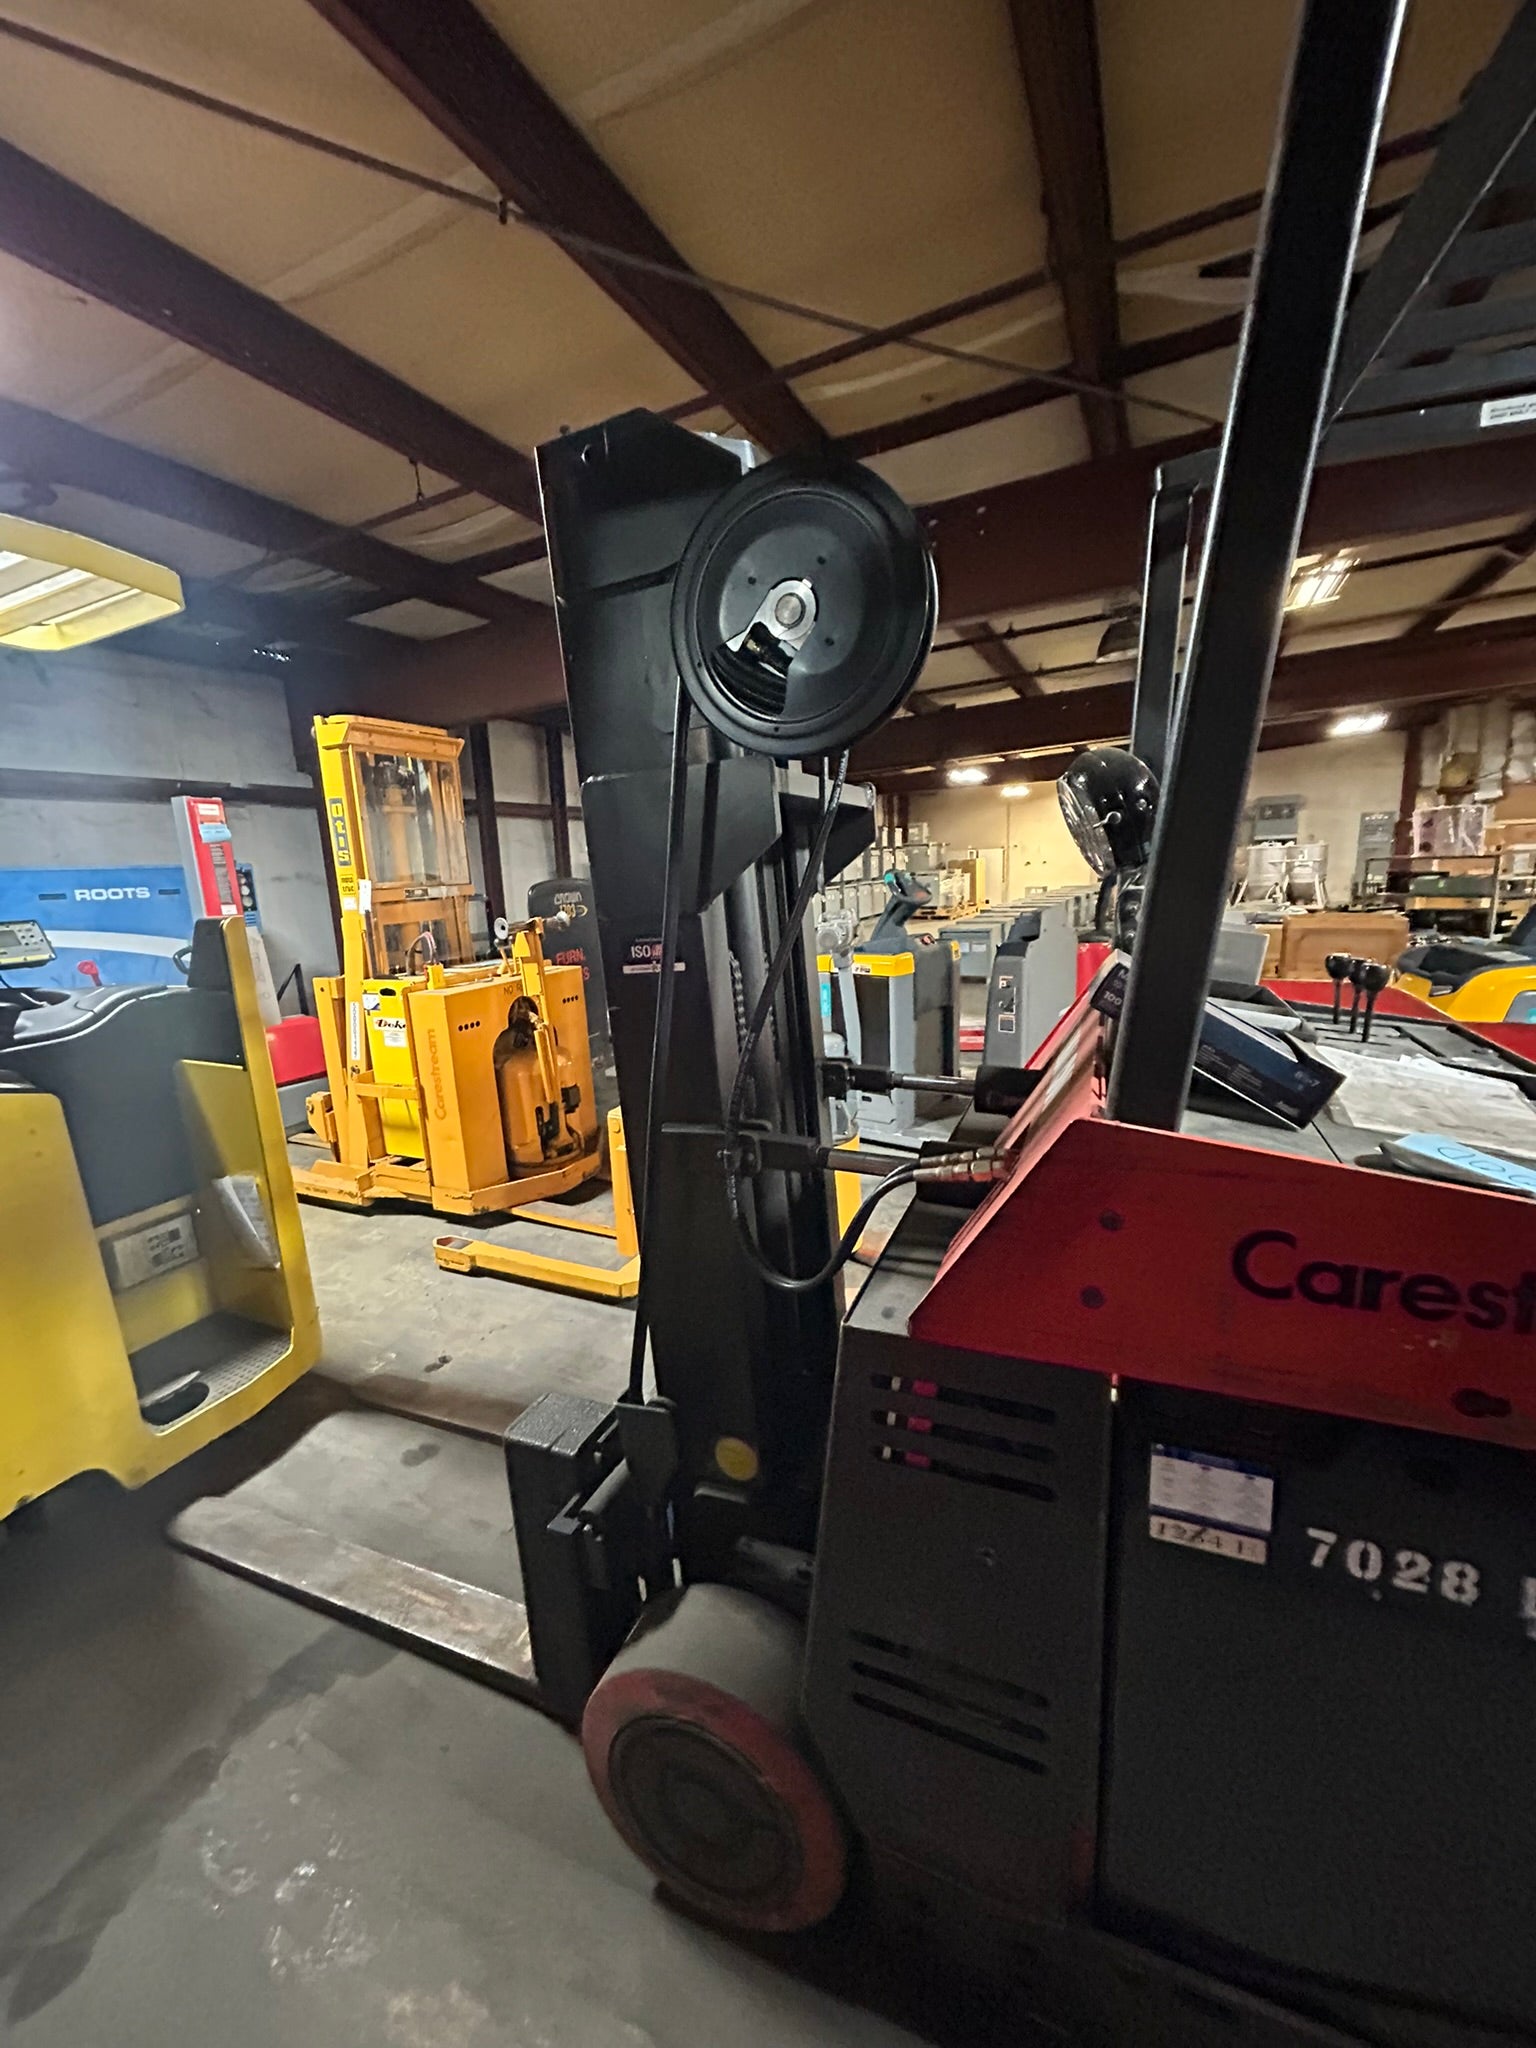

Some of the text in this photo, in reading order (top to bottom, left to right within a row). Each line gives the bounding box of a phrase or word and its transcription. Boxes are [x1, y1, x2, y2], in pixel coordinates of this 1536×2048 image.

[74, 886, 151, 901] ROOTS
[630, 944, 652, 958] ISO
[427, 1028, 448, 1120] Carestream
[1306, 1526, 1481, 1607] 7028
